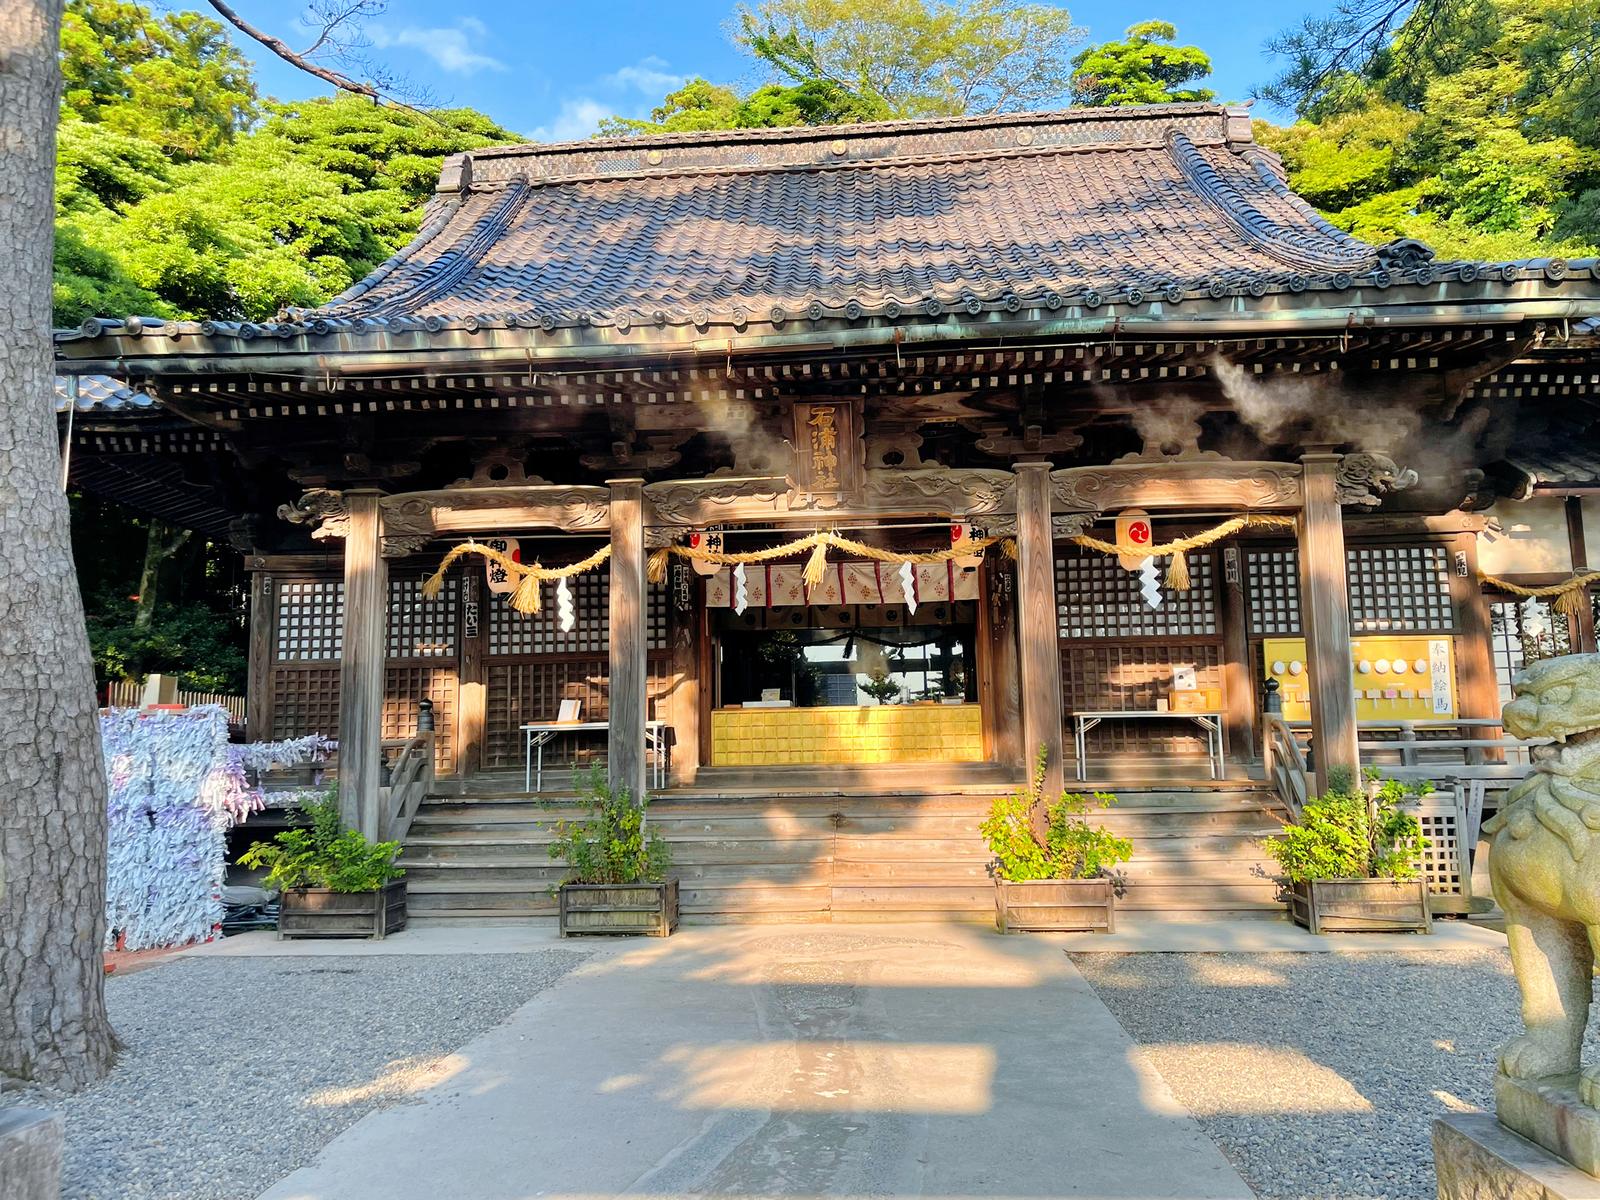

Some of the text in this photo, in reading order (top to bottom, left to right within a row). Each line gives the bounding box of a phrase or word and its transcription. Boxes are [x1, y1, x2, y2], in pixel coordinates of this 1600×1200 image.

[808, 407, 840, 489] 石浦神社
[1432, 643, 1448, 711] 奉納絵馬
